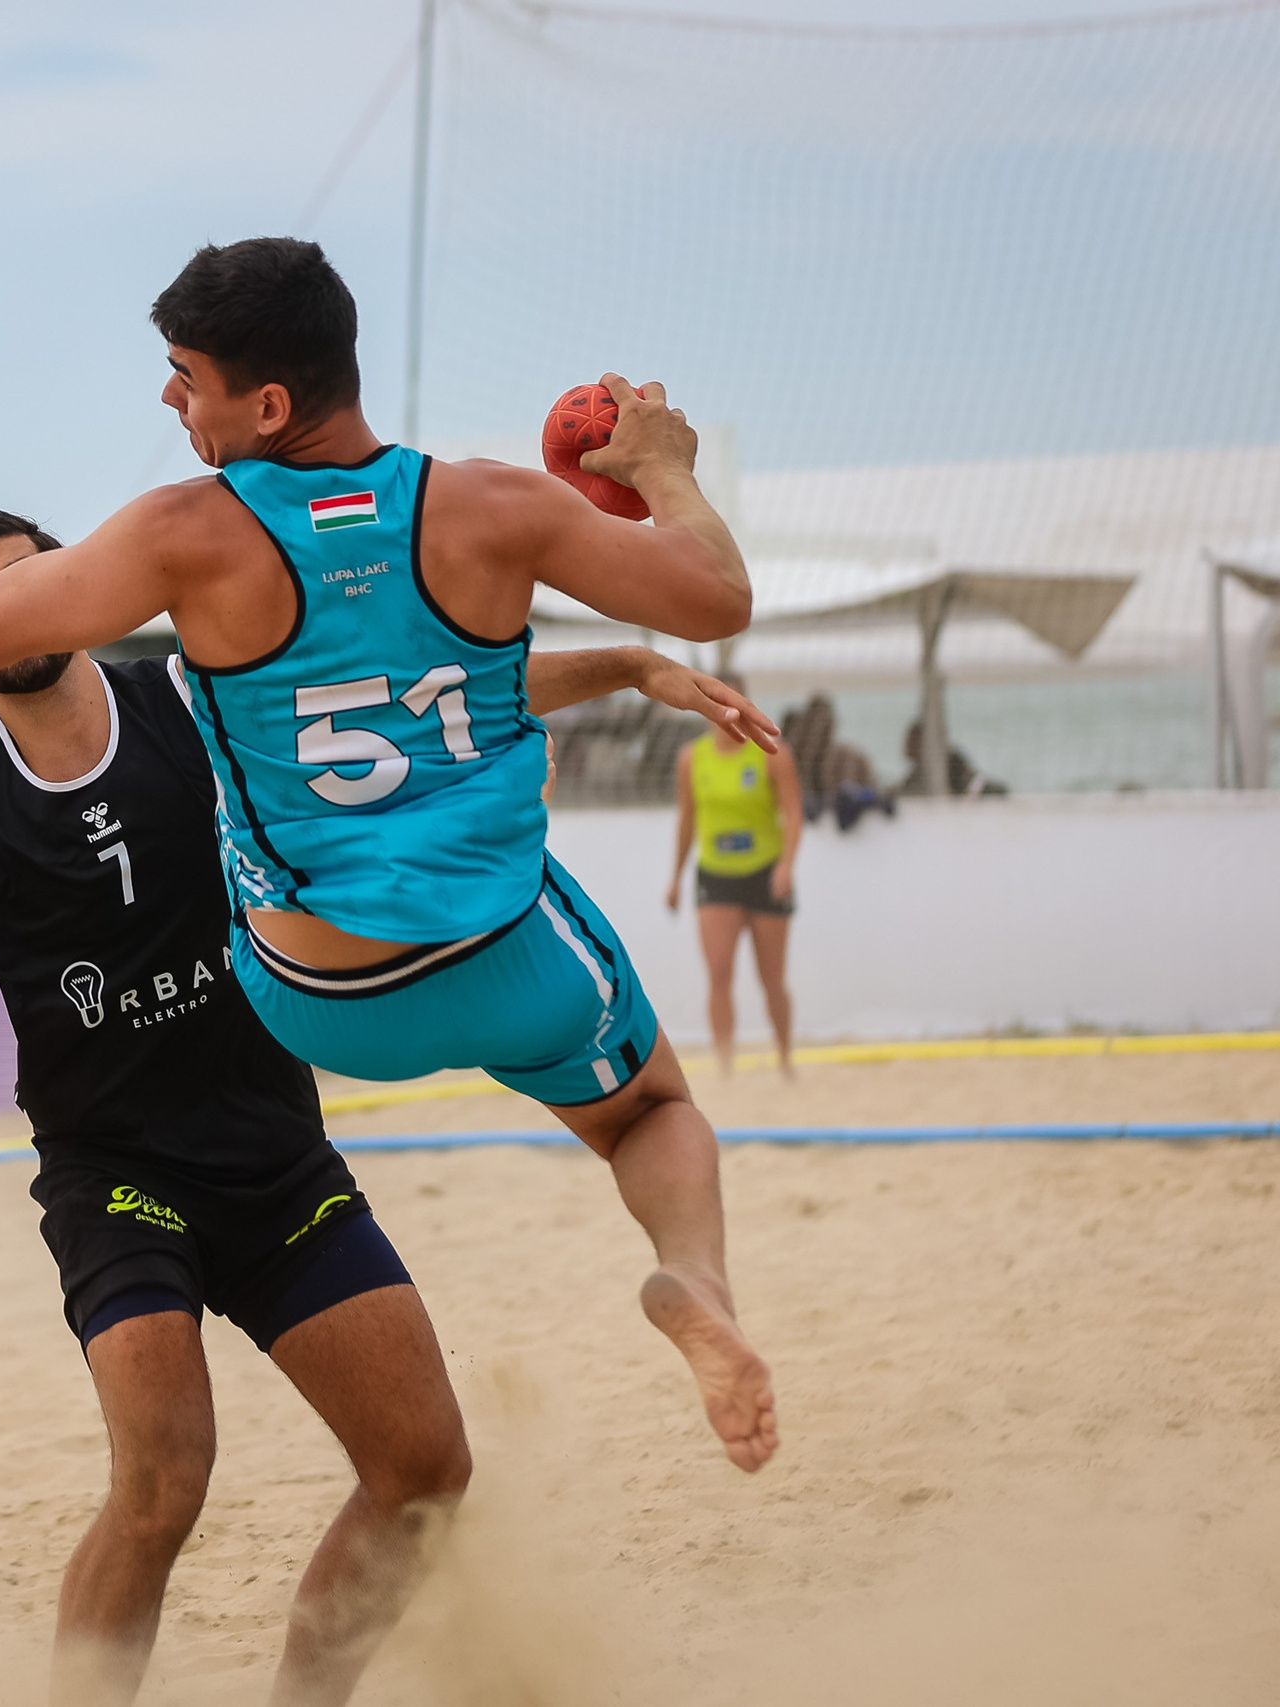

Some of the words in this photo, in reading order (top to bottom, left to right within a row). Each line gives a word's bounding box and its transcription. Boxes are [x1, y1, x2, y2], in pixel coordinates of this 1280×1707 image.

[321, 569, 355, 583] LUPA
[356, 561, 390, 577] LAKE
[344, 582, 373, 597] BHC
[294, 662, 481, 807] 51
[86, 819, 122, 844] hummel
[97, 840, 135, 905] 7
[132, 994, 208, 1029] ELEKTRO
